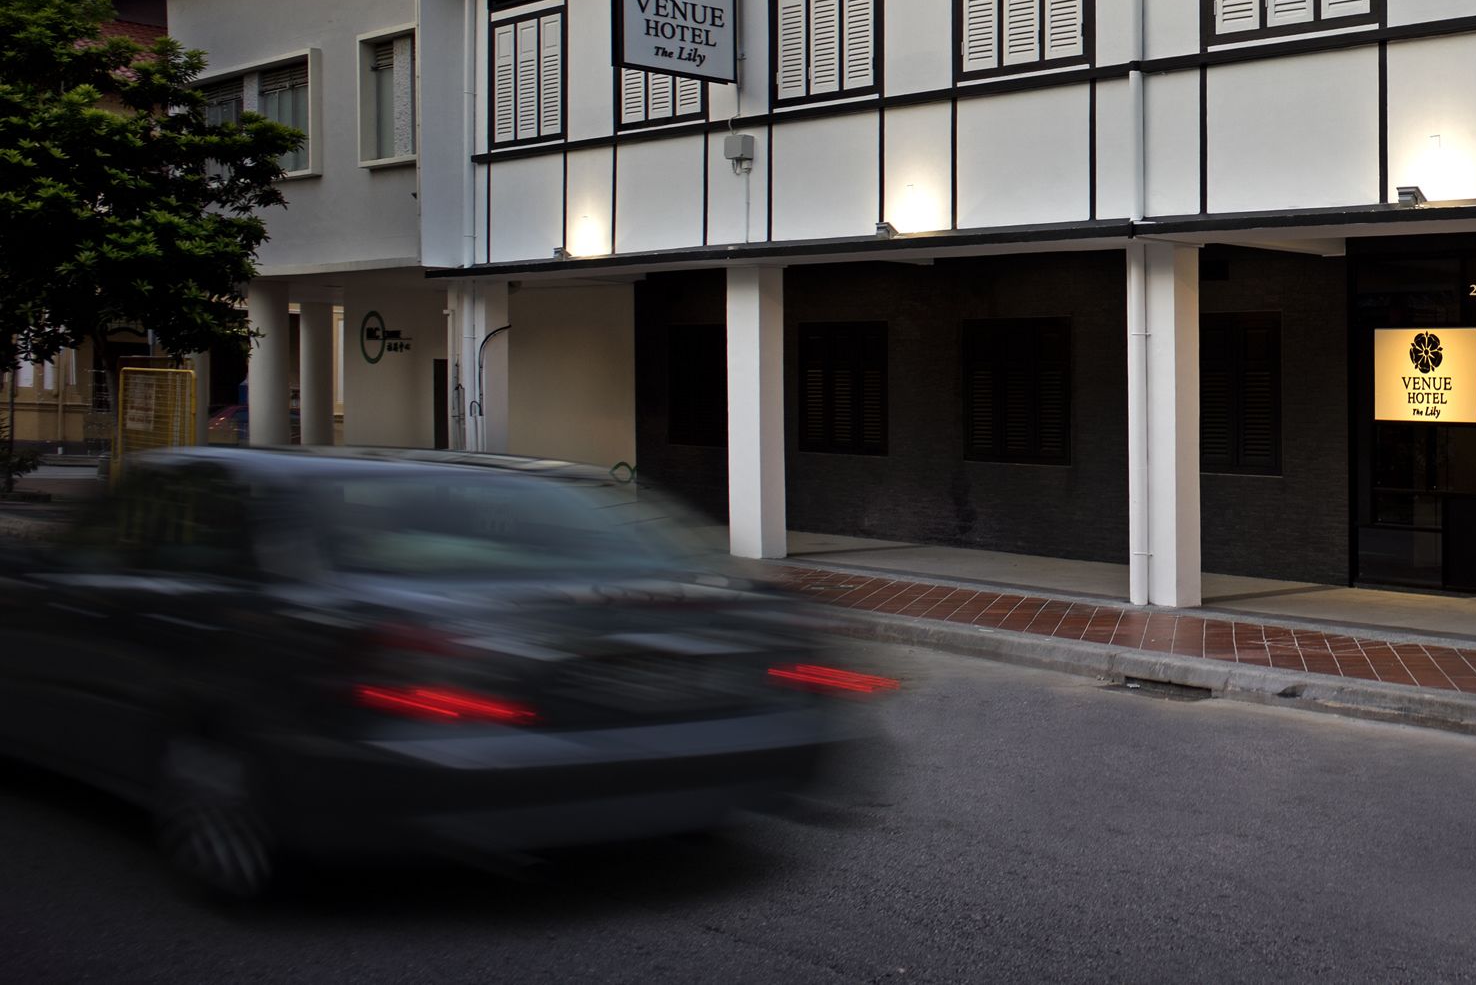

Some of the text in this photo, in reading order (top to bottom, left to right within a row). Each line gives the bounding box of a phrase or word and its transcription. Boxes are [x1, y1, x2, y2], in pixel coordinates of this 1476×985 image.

[644, 18, 717, 47] HOTEL
[654, 45, 706, 67] The Lily
[1402, 376, 1453, 391] VENUE
[1407, 392, 1448, 405] HOTEL
[1412, 406, 1441, 419] The Lily
